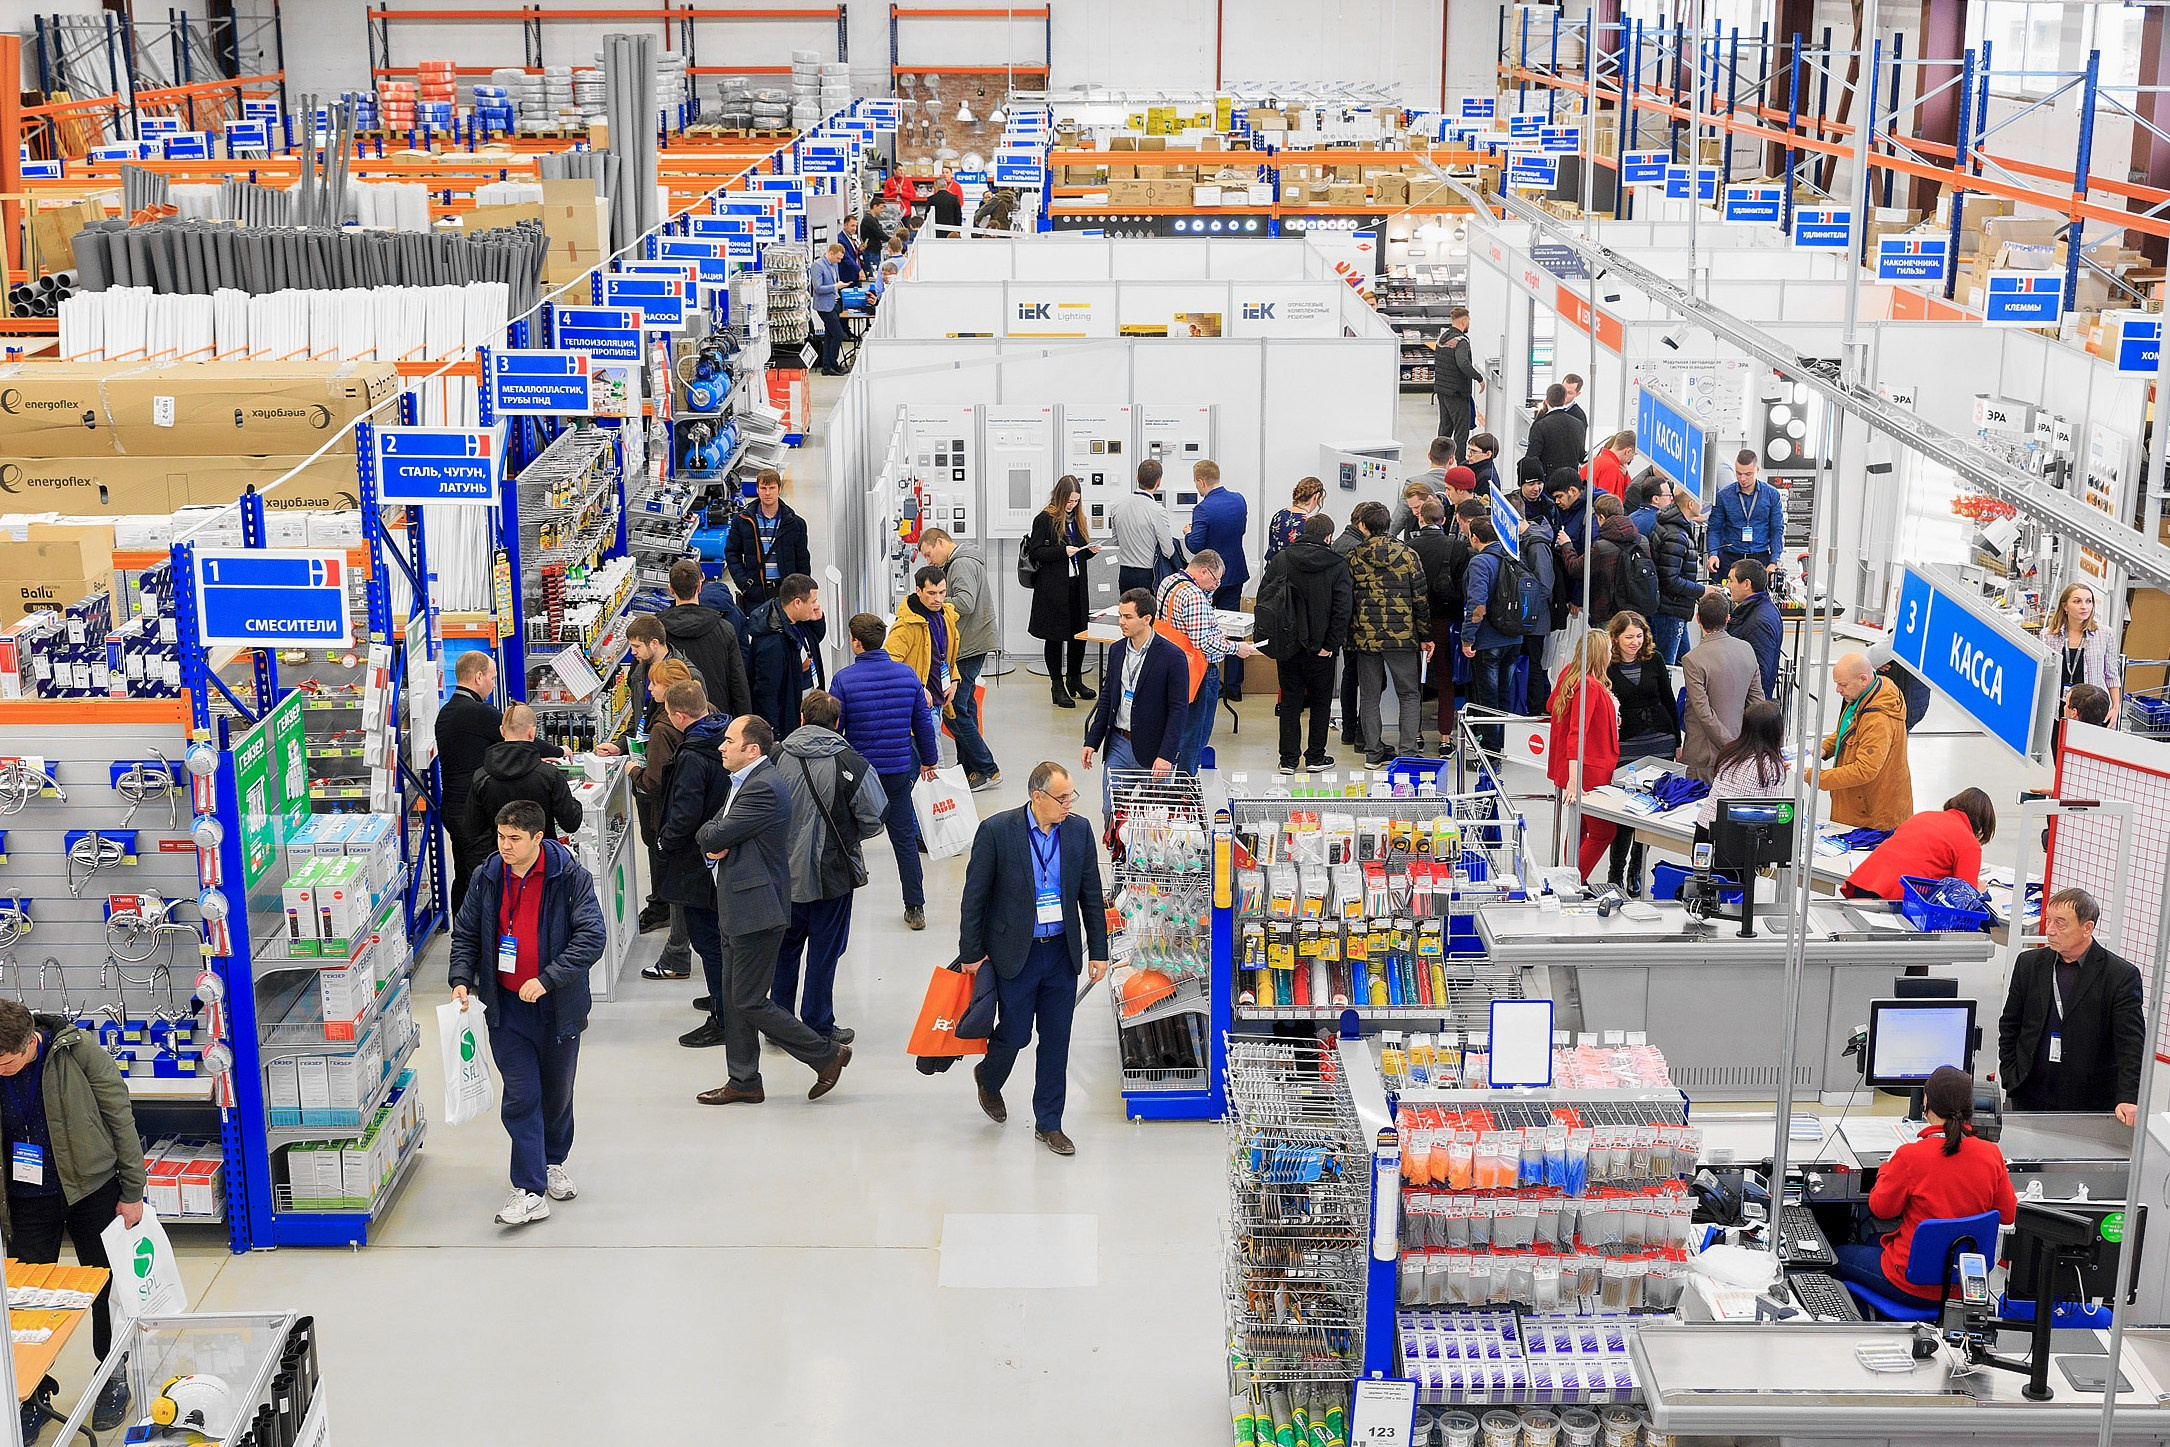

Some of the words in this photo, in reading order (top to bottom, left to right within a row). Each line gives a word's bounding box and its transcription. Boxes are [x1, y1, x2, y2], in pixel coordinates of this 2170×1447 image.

[46, 166, 57, 174] 11
[791, 181, 800, 190] 11
[722, 205, 728, 214] 9
[697, 222, 703, 231] 8
[1803, 231, 1847, 239] УДЛИНИТЕЛИ
[664, 244, 670, 254] 7
[1883, 259, 1940, 268] НАКОНЕЧНИКИ,
[1896, 266, 1926, 275] ГИЛЬЗЫ
[611, 282, 618, 293] 5
[2004, 302, 2042, 312] КЛЕММЫ
[562, 313, 571, 325] 4
[644, 313, 679, 321] НАСОСЫ
[1057, 312, 1091, 322] Lighting
[564, 338, 636, 348] ТЕПЛОИЗОЛЯЦИЯ,
[500, 357, 509, 372] 3
[502, 385, 584, 395] МЕТАЛЛОПЛАСТИК,
[25, 399, 79, 411] energoflex
[502, 396, 530, 405] ТРУБЫ
[532, 396, 551, 406] ПНД
[1892, 395, 1912, 405] ЭРА
[251, 408, 306, 419] energoflex
[1986, 410, 2007, 423] ЭРА
[1643, 412, 1648, 435] 1
[386, 435, 397, 453] 2
[1656, 420, 1683, 462] КАССЫ
[1690, 448, 1697, 475] 2
[399, 466, 442, 480] СТАЛЬ,
[444, 466, 487, 480] ЧУГУН,
[27, 475, 92, 489] energoflex
[439, 483, 487, 493] ЛАТУНЬ
[265, 497, 330, 510] energoflex
[208, 561, 220, 582] 1
[20, 587, 54, 599] Ballu
[1906, 600, 1917, 634] 3
[245, 618, 337, 633] СМЕСИТЕЛИ
[1950, 631, 2002, 706] КАССА
[276, 703, 300, 735] ГЕЙЗЕР
[239, 737, 265, 771] ГЕЙЗЕР
[933, 799, 956, 815] ABB
[138, 1274, 161, 1301] SPL
[1369, 1427, 1395, 1438] 123
